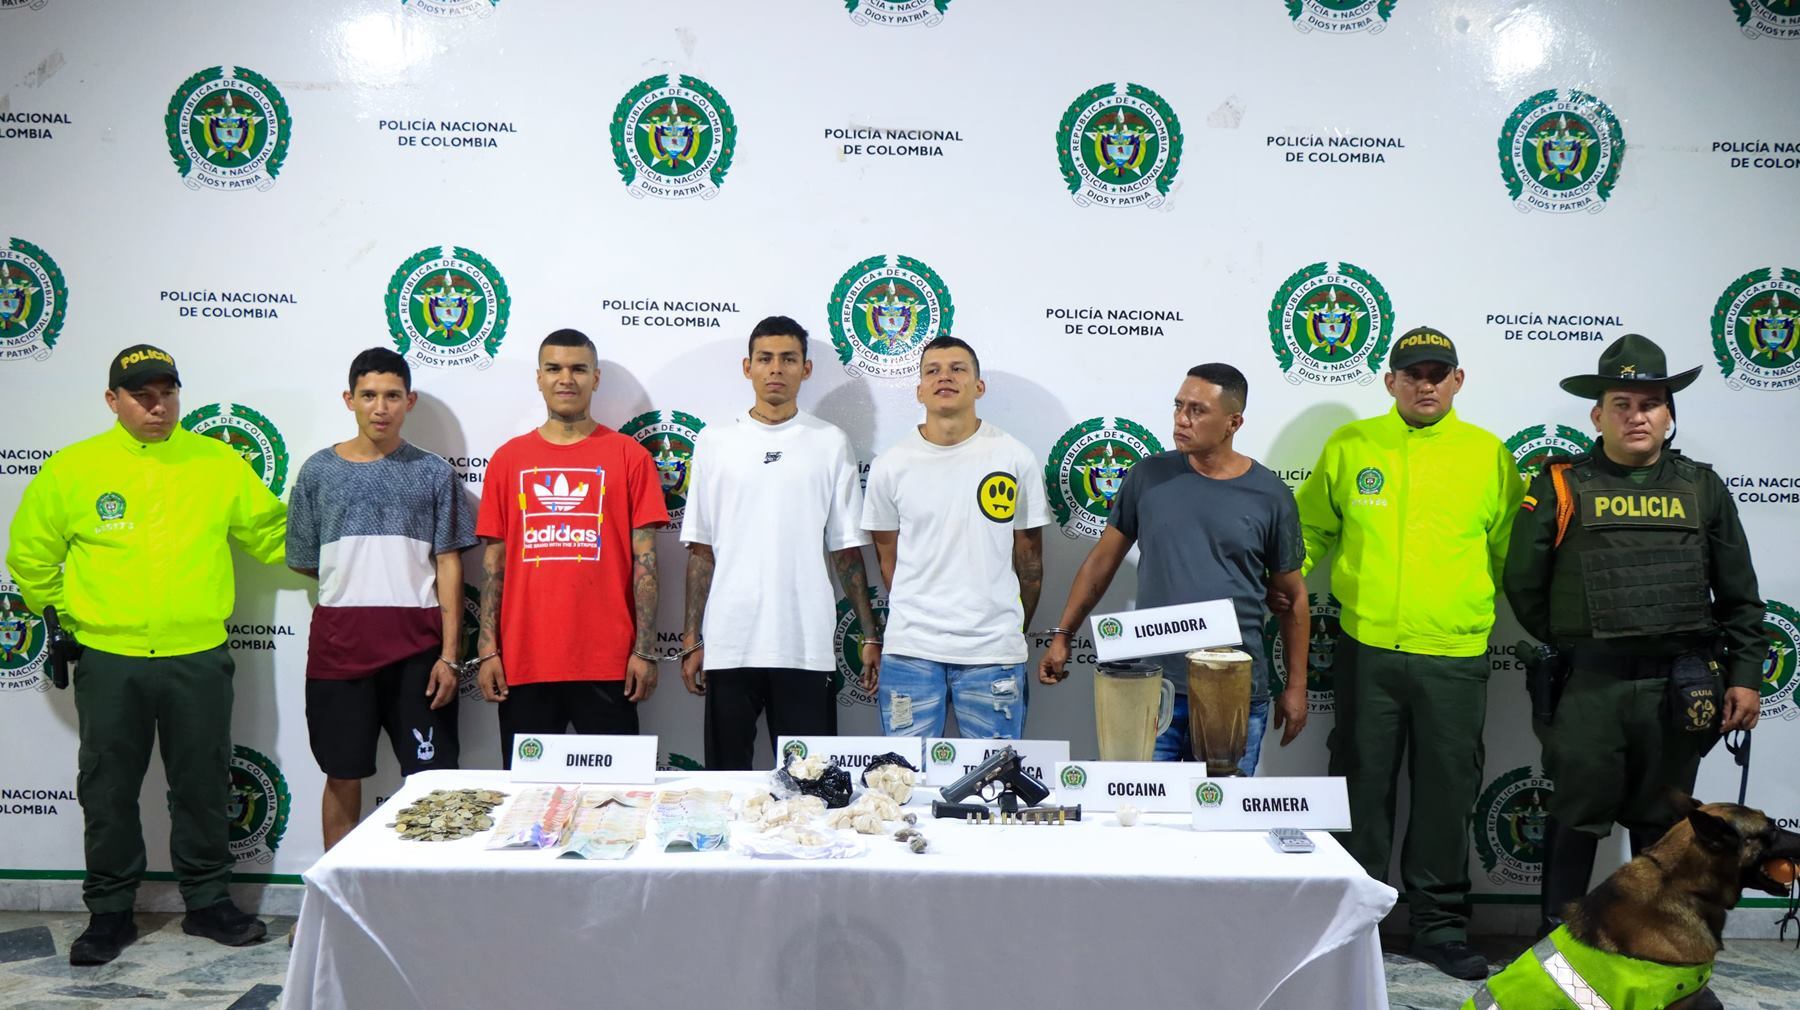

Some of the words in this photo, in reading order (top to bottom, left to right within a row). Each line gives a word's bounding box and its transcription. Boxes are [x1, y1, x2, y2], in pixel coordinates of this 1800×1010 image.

[896, 9, 929, 24] PATRIA
[1341, 0, 1378, 19] NACION
[1340, 17, 1373, 31] PATRIA
[223, 80, 236, 88] DE
[246, 86, 276, 136] COLOMBIA
[669, 88, 682, 96] DE
[692, 94, 722, 145] COLOMBIA
[379, 118, 436, 131] POLICÍA
[440, 121, 517, 133] NACIONAL
[1138, 103, 1168, 153] COLOMBIA
[0, 128, 53, 139] LOMBIA
[824, 127, 882, 140] POLICÍA
[886, 130, 963, 141] NACIONAL
[398, 135, 417, 146] DE
[421, 136, 498, 148] COLOMBIA
[1266, 134, 1324, 147] POLICÍA
[1328, 137, 1405, 148] NACIONAL
[1712, 140, 1770, 153] POLICÍA
[843, 145, 862, 155] DE
[866, 145, 944, 156] COLOMBIA
[1285, 152, 1304, 162] DE
[1308, 152, 1386, 163] COLOMBIA
[229, 147, 273, 176] NACIONAL
[1731, 157, 1750, 168] DE
[674, 156, 717, 184] NACIONAL
[229, 174, 262, 188] PATRIA
[1120, 164, 1163, 193] NACIONAL
[1561, 170, 1604, 198] NACIONAL
[674, 182, 706, 197] PATRIA
[1119, 191, 1151, 205] PATRIA
[1560, 197, 1592, 211] PATRIA
[22, 257, 52, 307] COLOMBIA
[1770, 281, 1784, 289] DE
[160, 288, 217, 302] POLICÍA
[221, 292, 298, 304] NACIONAL
[466, 266, 495, 315] COLOMBIA
[602, 298, 660, 311] POLICÍA
[663, 301, 740, 312] NACIONAL
[909, 275, 939, 324] COLOMBIA
[1350, 281, 1379, 331] COLOMBIA
[179, 306, 198, 317] DE
[202, 307, 278, 319] COLOMBIA
[1046, 307, 1103, 320] POLICÍA
[1107, 310, 1184, 321] NACIONAL
[1486, 312, 1543, 325] POLICÍA
[1547, 315, 1624, 326] NACIONAL
[621, 315, 640, 326] DE
[643, 316, 721, 328] COLOMBIA
[6, 318, 49, 346] NACIONAL
[1064, 324, 1083, 335] DE
[1087, 325, 1164, 336] COLOMBIA
[1504, 330, 1523, 340] DE
[1527, 330, 1604, 341] COLOMBIA
[449, 326, 492, 354] NACIONAL
[1400, 333, 1451, 350] POLICIA
[6, 344, 39, 358] PATRIA
[1331, 342, 1373, 370] NACIONAL
[449, 353, 481, 366] PATRIA
[1330, 369, 1362, 383] PATRIA
[661, 424, 675, 432] DE
[220, 417, 234, 425] DE
[243, 423, 273, 472] COLOMBIA
[1545, 438, 1558, 446] DE
[1738, 492, 1800, 503] COLOMB
[1595, 495, 1686, 519] POLICIA
[525, 524, 597, 543] adidas
[1, 584, 14, 592] DE
[1317, 606, 1330, 614] DE
[835, 611, 856, 653] REPUBLI
[1134, 617, 1208, 639] LICUADORA
[229, 639, 277, 650] OMBIA
[8, 650, 49, 677] NACIONAL
[1492, 660, 1511, 671] DE
[8, 675, 40, 689] PATRIA
[840, 664, 861, 687] POLIC
[1760, 704, 1788, 717] ATRIA
[566, 753, 613, 767] DINERO
[246, 764, 276, 811] COLOMBIA
[1107, 782, 1166, 797] COCAINA
[1531, 779, 1545, 787] DE
[2, 789, 77, 801] NACIONAL
[0, 804, 58, 815] LOMBIA
[1242, 797, 1309, 813] GRAMERA
[230, 821, 272, 849] NACIONAL
